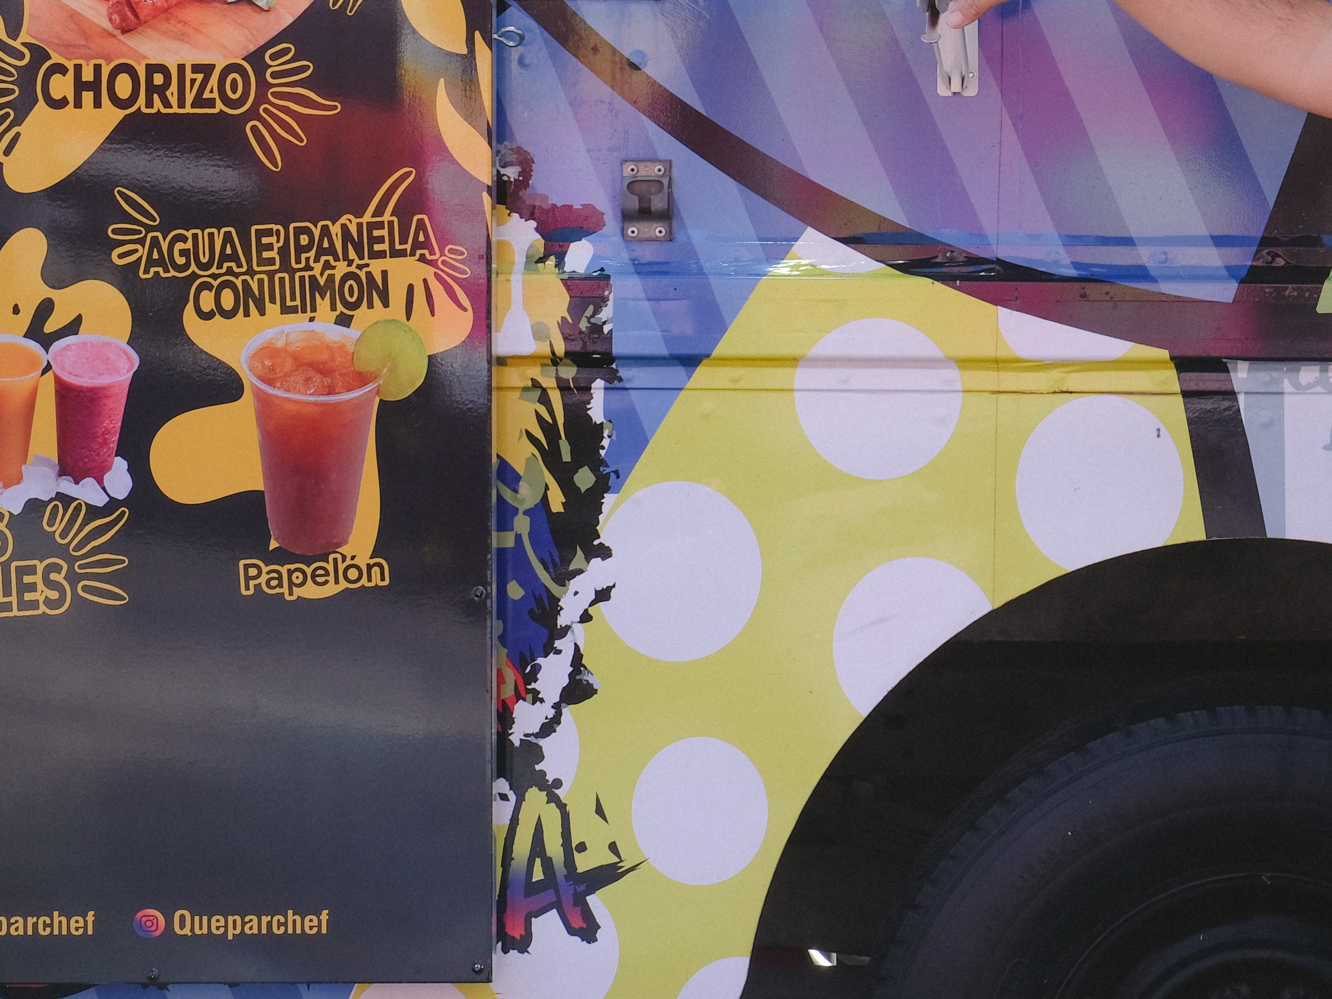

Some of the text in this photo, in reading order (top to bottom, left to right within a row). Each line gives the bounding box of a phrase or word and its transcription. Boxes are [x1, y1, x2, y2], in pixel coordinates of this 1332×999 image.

[38, 61, 254, 113] CHORIZO
[142, 230, 245, 276] AGUA
[192, 276, 268, 321] CON
[241, 553, 387, 598] Papelón
[172, 909, 329, 940] Queparchef
